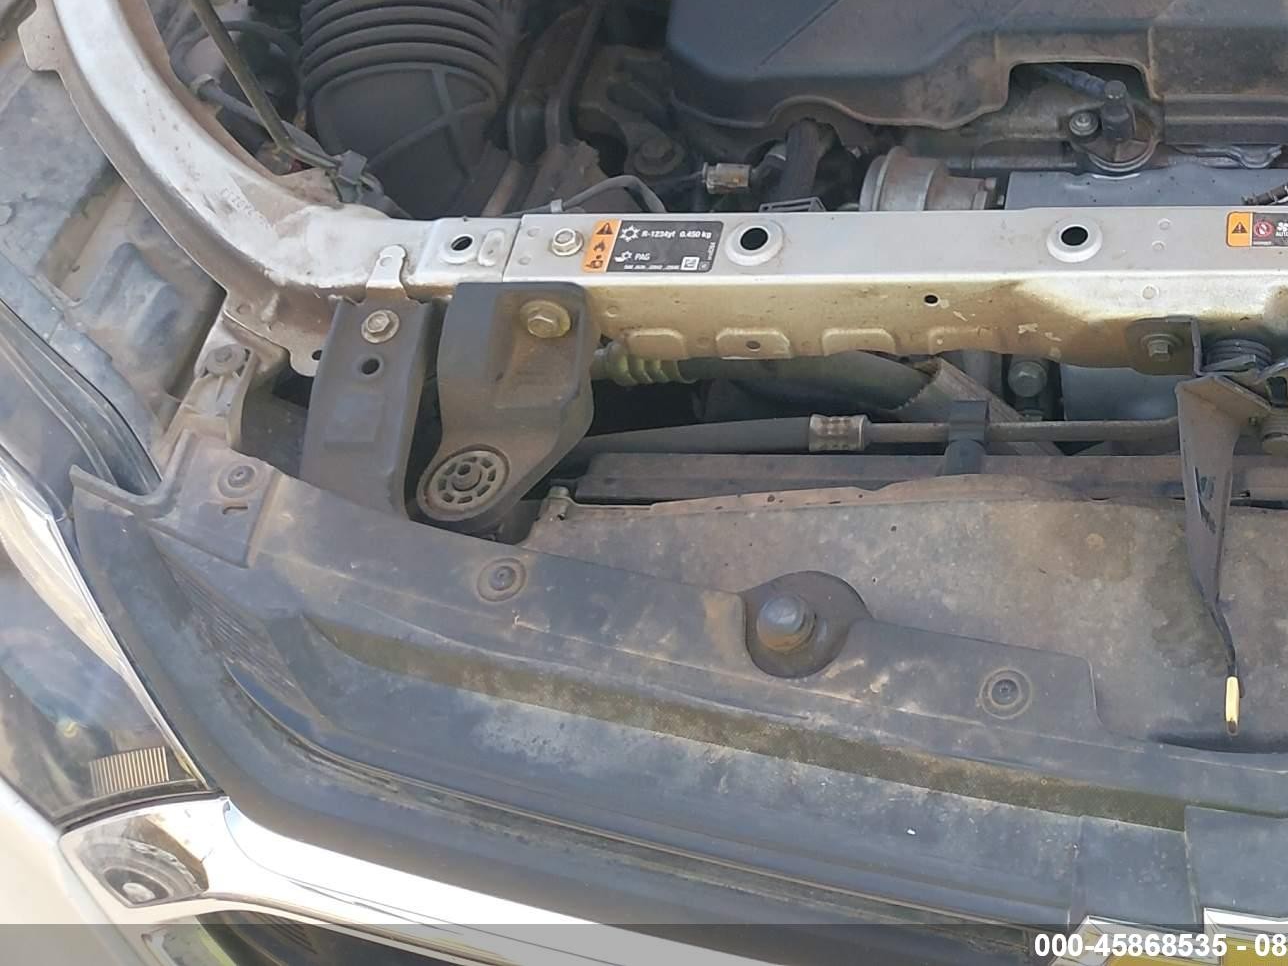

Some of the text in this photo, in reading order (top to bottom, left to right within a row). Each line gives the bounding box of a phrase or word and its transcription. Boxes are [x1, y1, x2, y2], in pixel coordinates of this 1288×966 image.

[641, 230, 677, 240] R-1234yf
[701, 230, 712, 240] kg
[634, 252, 650, 261] PAG
